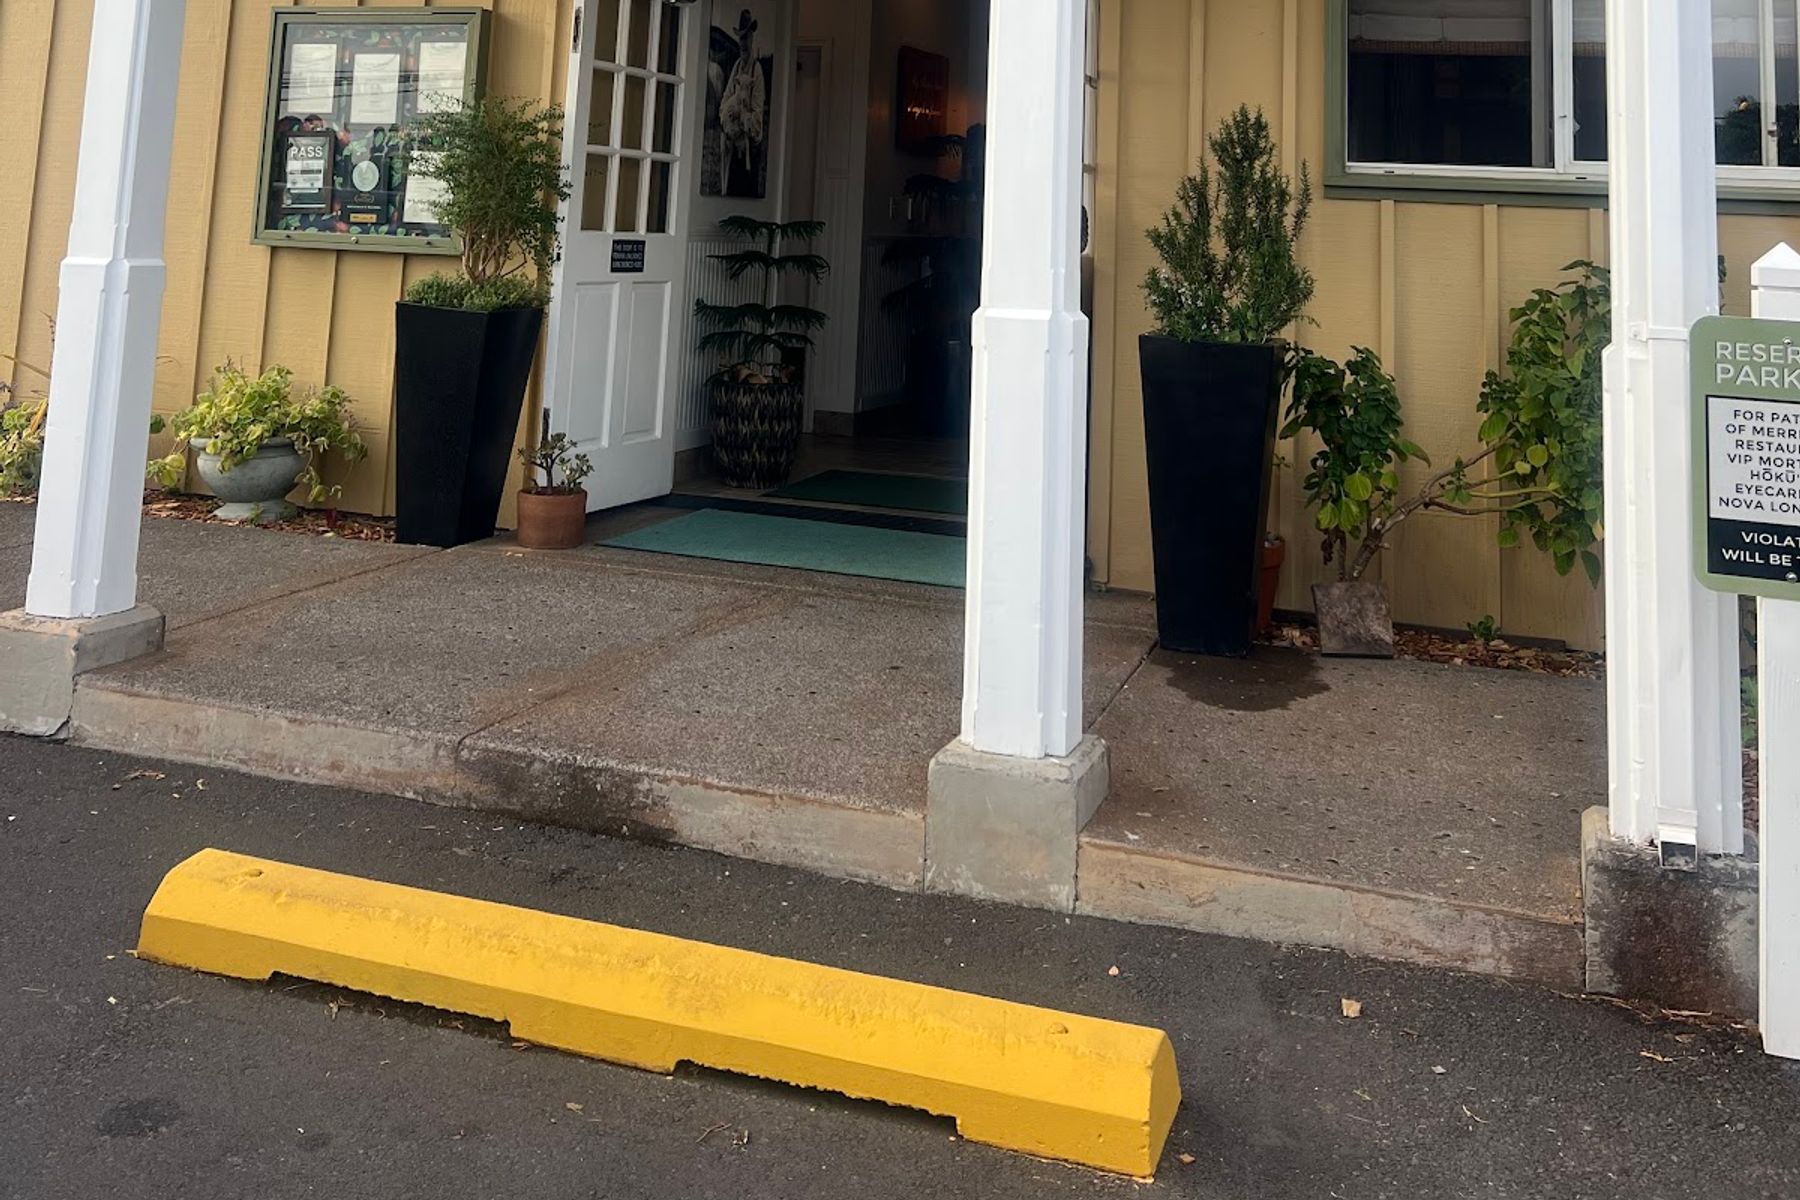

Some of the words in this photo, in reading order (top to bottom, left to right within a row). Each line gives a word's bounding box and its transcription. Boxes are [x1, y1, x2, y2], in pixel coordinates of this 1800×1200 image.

[290, 145, 323, 158] PASS
[1715, 363, 1800, 390] PARK
[1733, 409, 1764, 422] FOR
[1771, 412, 1800, 424] PAT
[1725, 423, 1746, 435] OF
[1735, 439, 1800, 454] RESTAU
[1727, 453, 1752, 465] VIP
[1735, 482, 1800, 500] EYECAR
[1719, 496, 1765, 511] NOVA
[1770, 501, 1800, 514] LON
[1721, 547, 1765, 564] WILL
[1769, 553, 1792, 567] BE
